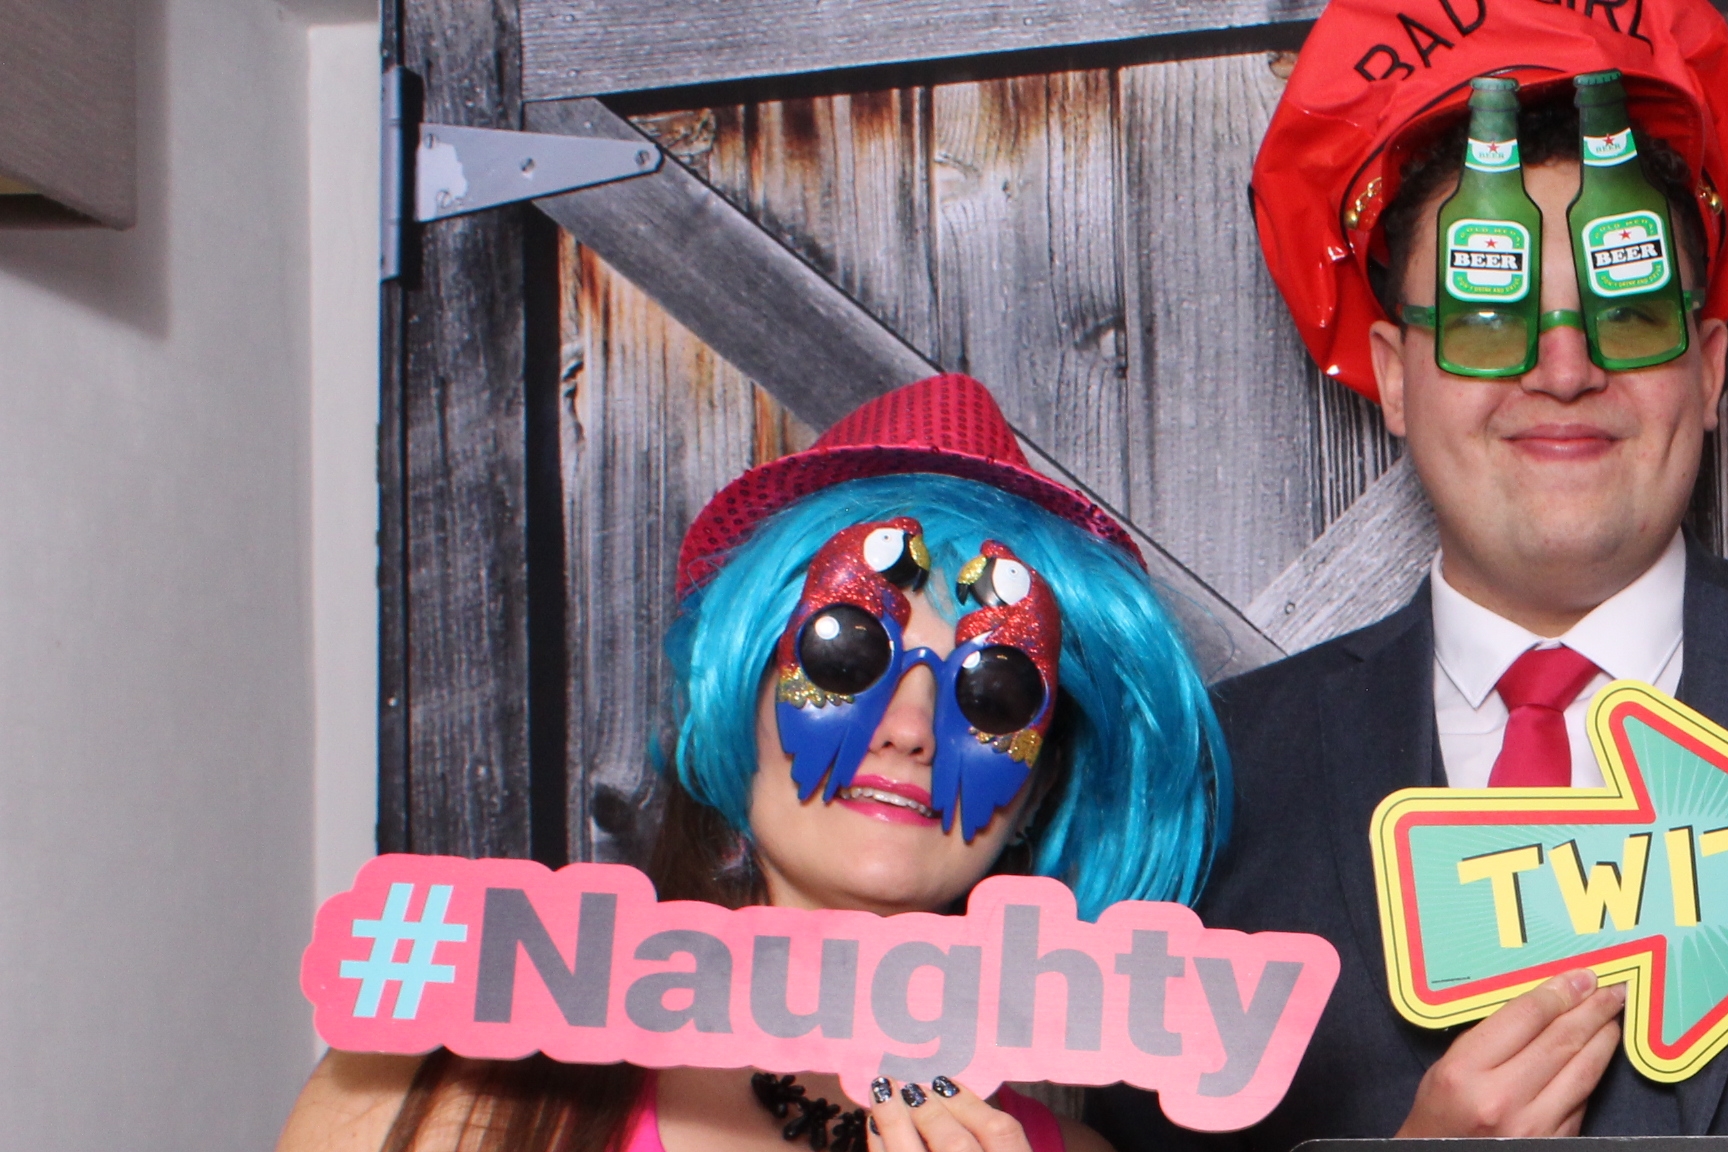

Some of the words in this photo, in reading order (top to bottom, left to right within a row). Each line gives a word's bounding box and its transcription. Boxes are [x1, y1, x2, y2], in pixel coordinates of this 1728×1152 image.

[1453, 251, 1519, 270] BEER
[1594, 242, 1659, 267] BEER
[338, 881, 1305, 1099] #Naughty
